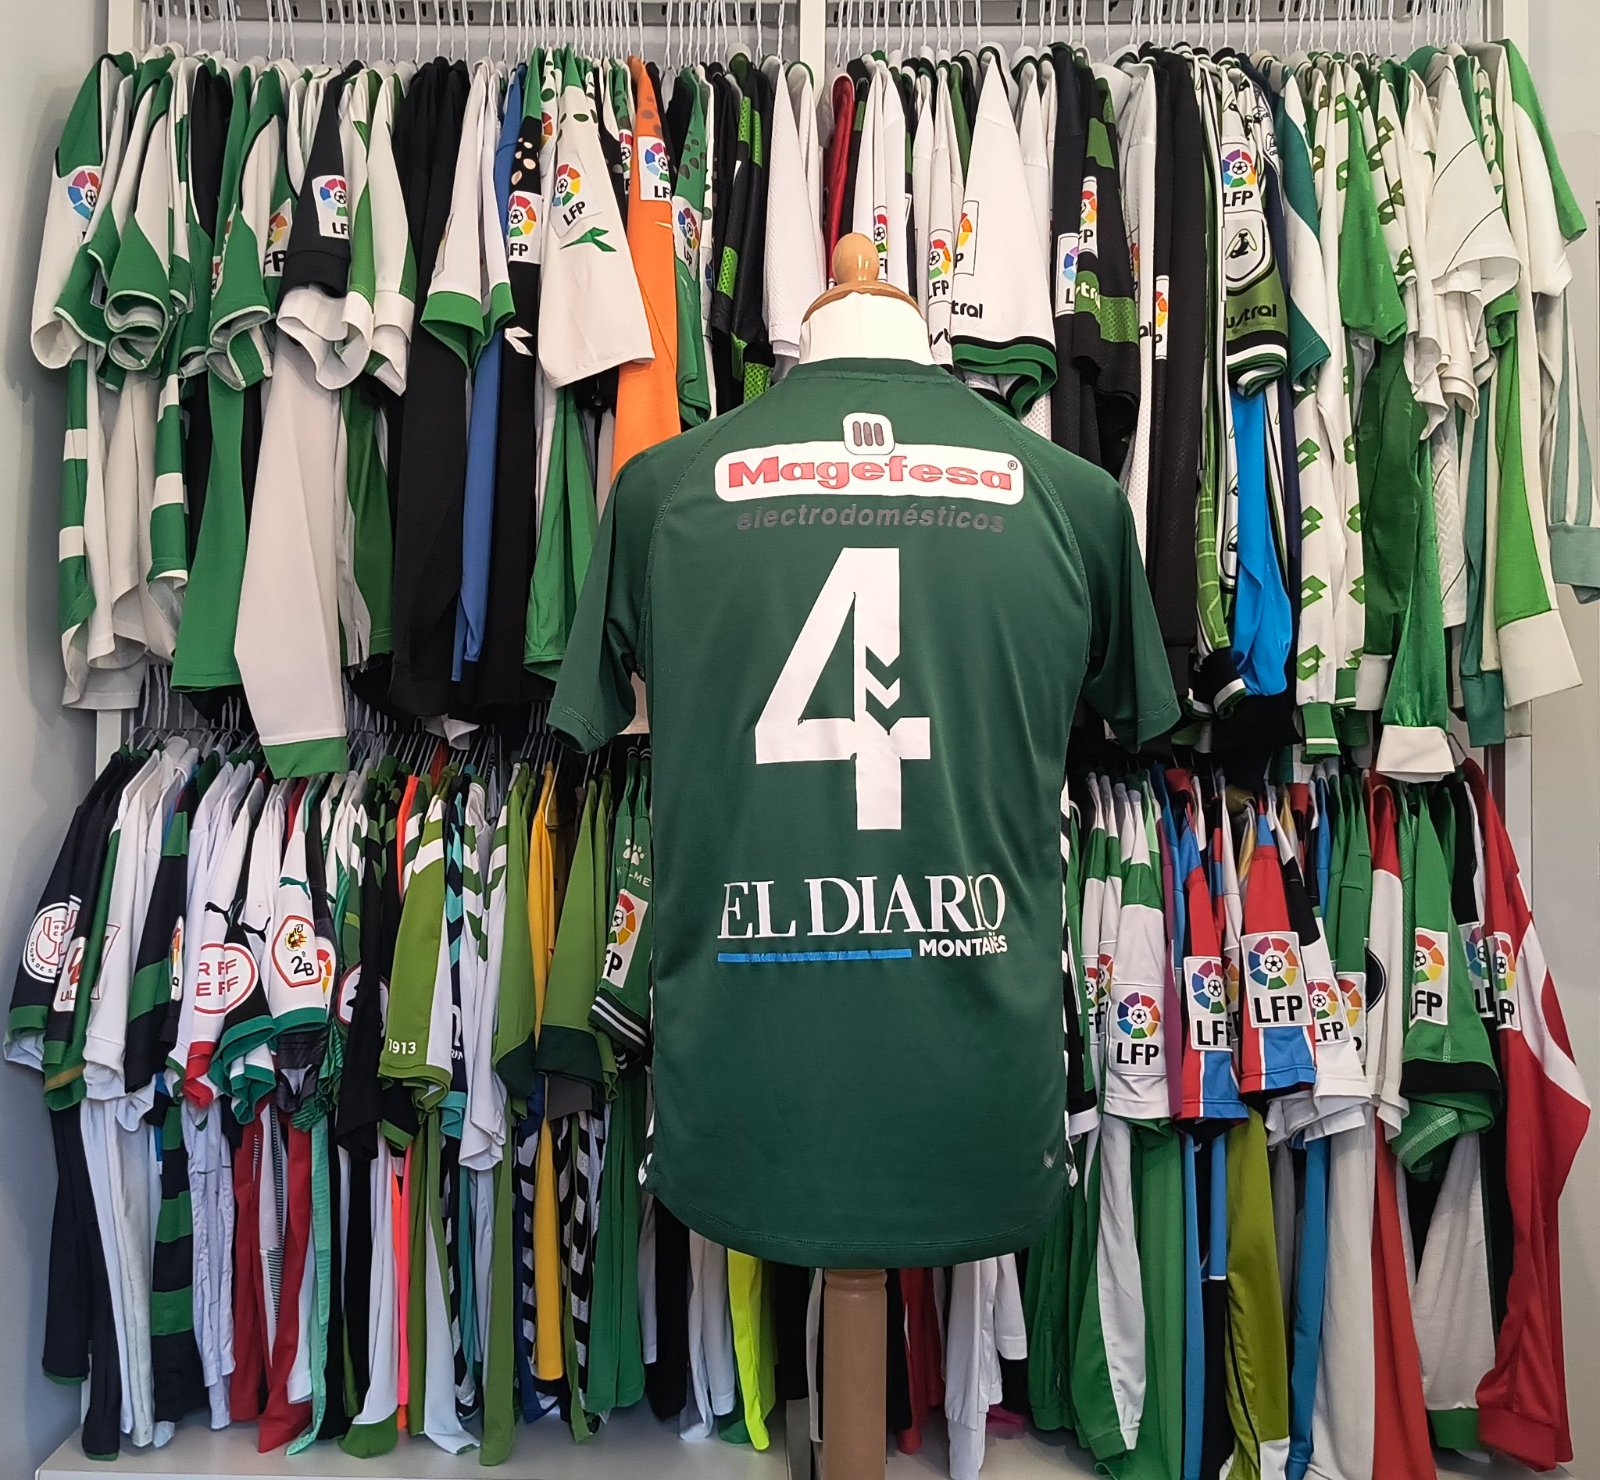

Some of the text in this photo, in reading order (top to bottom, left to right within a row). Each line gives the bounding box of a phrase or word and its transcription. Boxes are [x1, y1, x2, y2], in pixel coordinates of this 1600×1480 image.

[653, 185, 672, 199] LF
[562, 201, 586, 226] LFP
[331, 222, 350, 235] LF
[263, 249, 287, 274] FP
[509, 243, 528, 257] FP
[928, 280, 949, 299] FP
[951, 300, 983, 319] tral
[728, 456, 1012, 490] Magefesa
[736, 503, 1005, 533] electrodomésticos
[755, 547, 931, 831] 4
[717, 873, 1006, 939] EL DIARIO
[1253, 995, 1303, 1024] LFP
[388, 1038, 416, 1055] 1913
[1116, 1042, 1160, 1066] LFP
